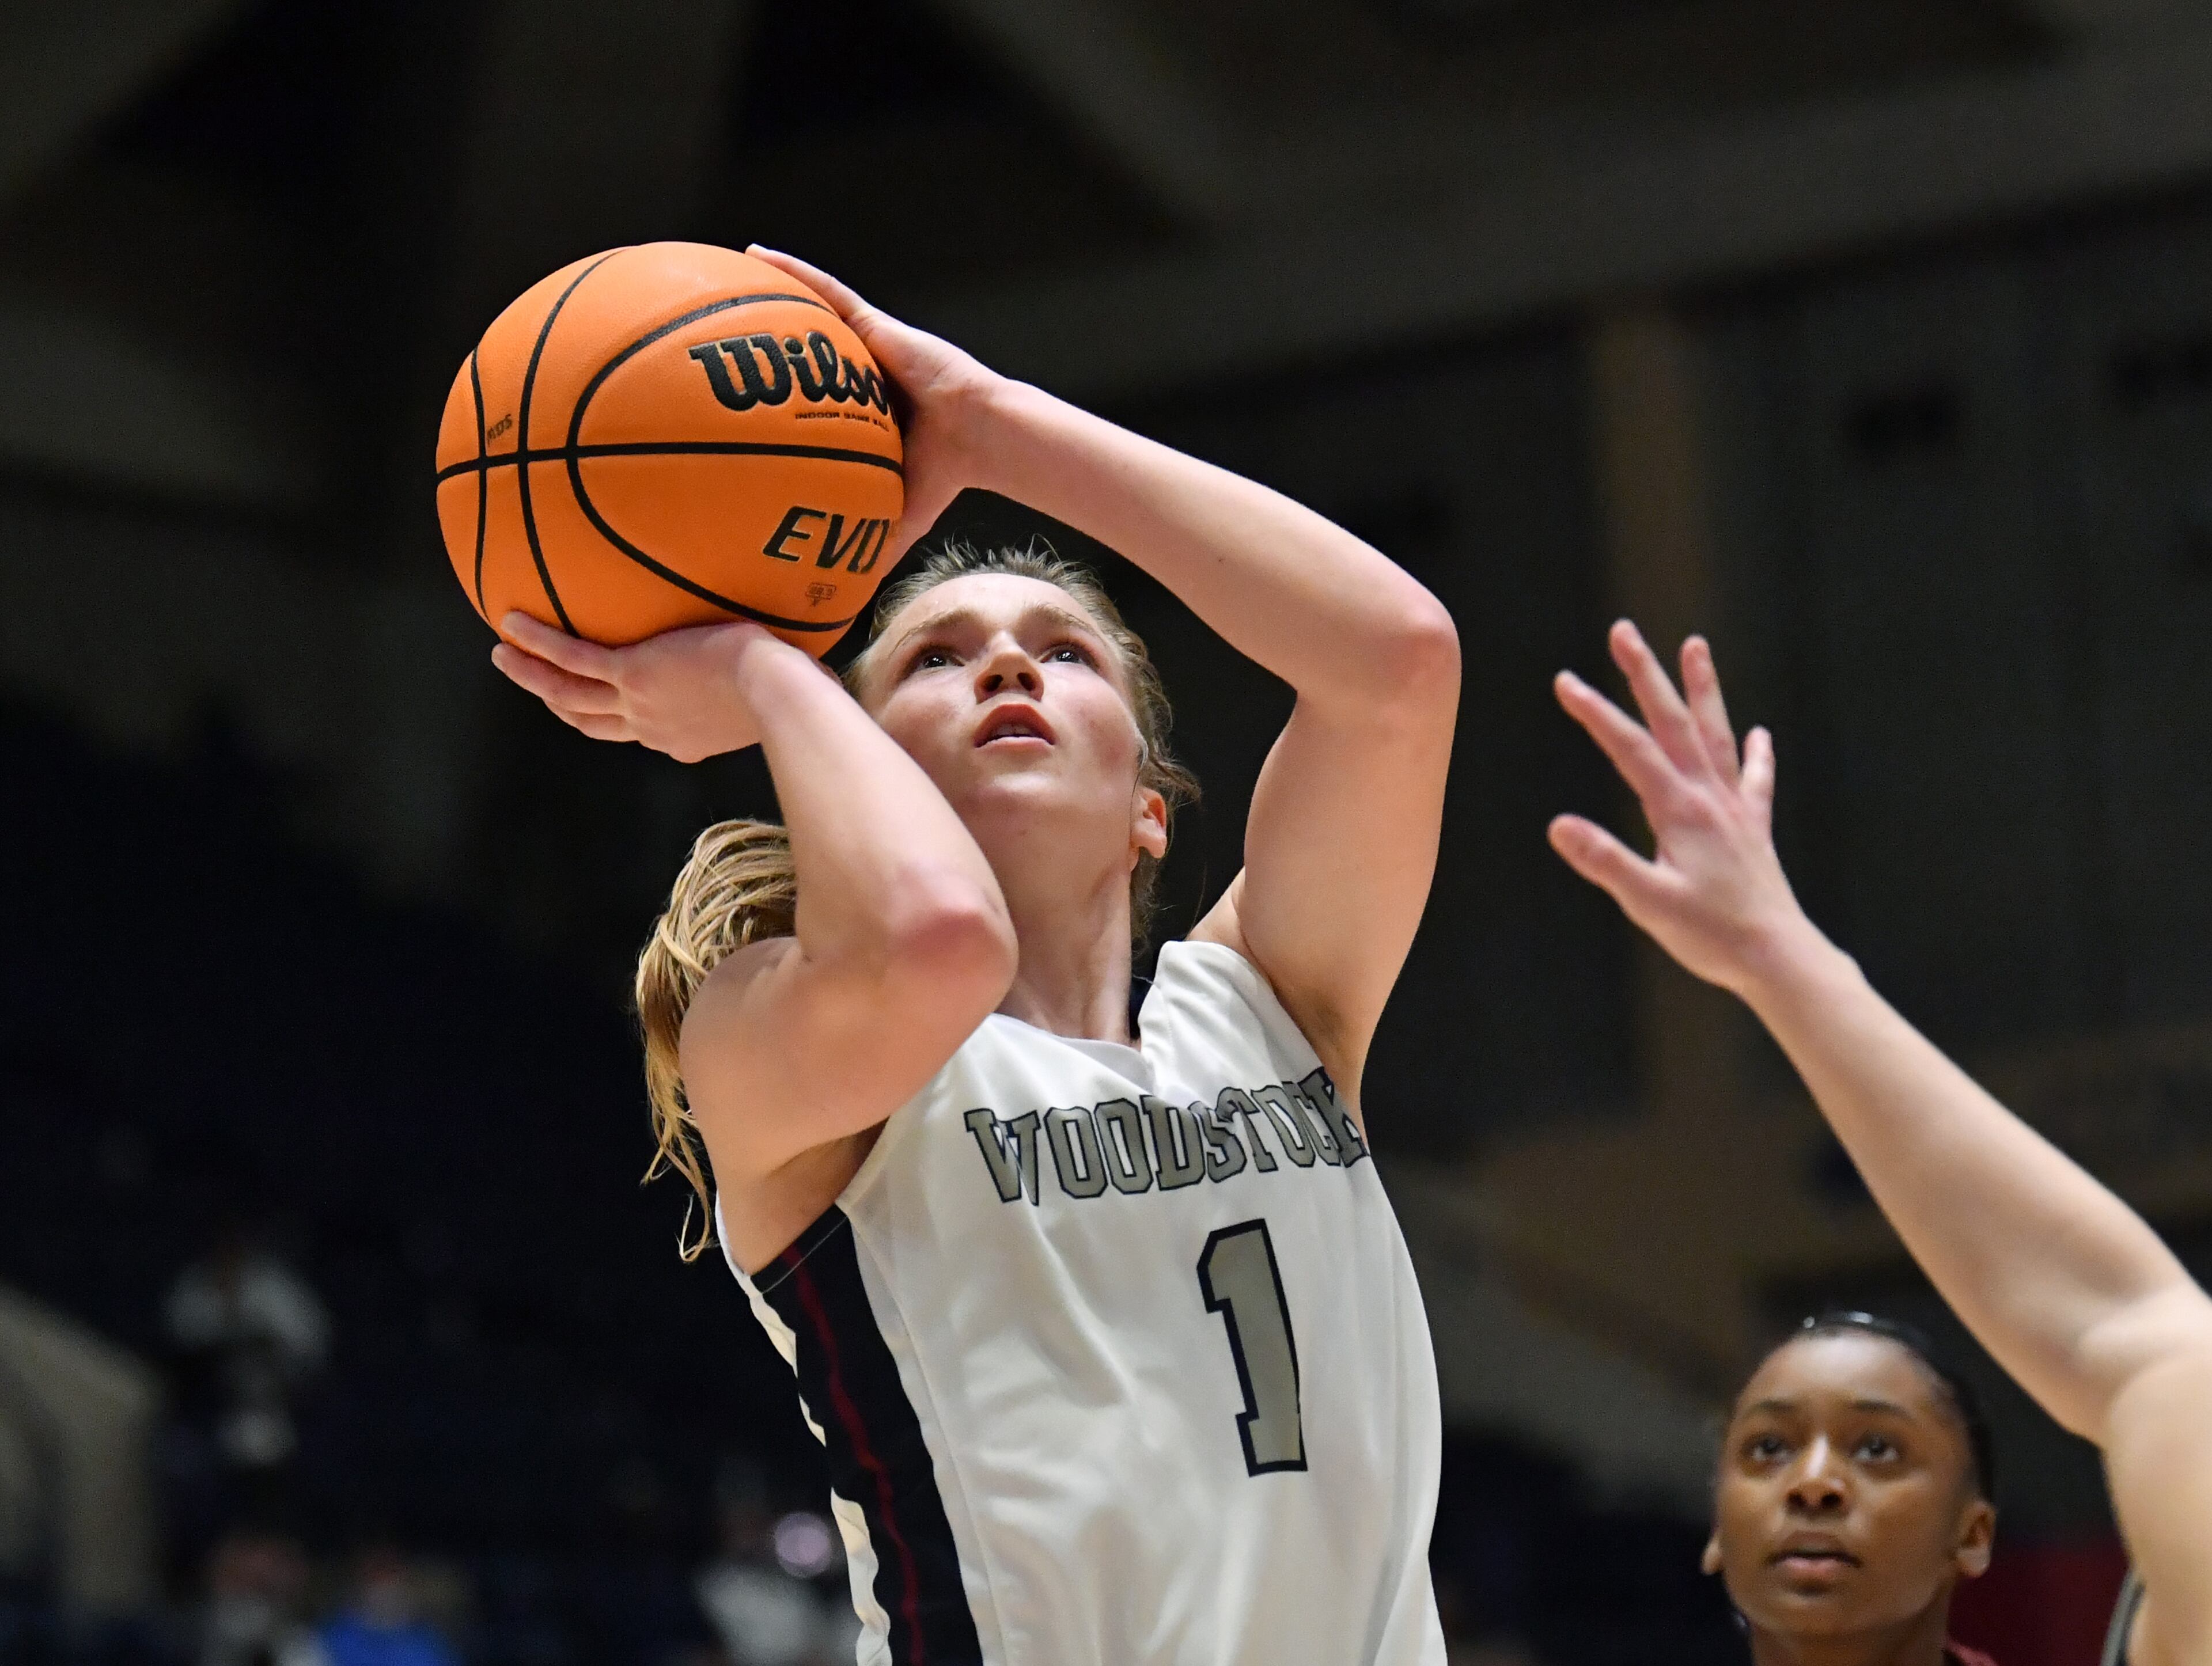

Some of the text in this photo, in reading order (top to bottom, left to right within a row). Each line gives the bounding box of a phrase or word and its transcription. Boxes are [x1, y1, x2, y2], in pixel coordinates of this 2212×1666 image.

[688, 331, 892, 416] Wilso
[964, 1066, 1370, 1206] WOODSTOCK
[1196, 1218, 1308, 1477] 1
